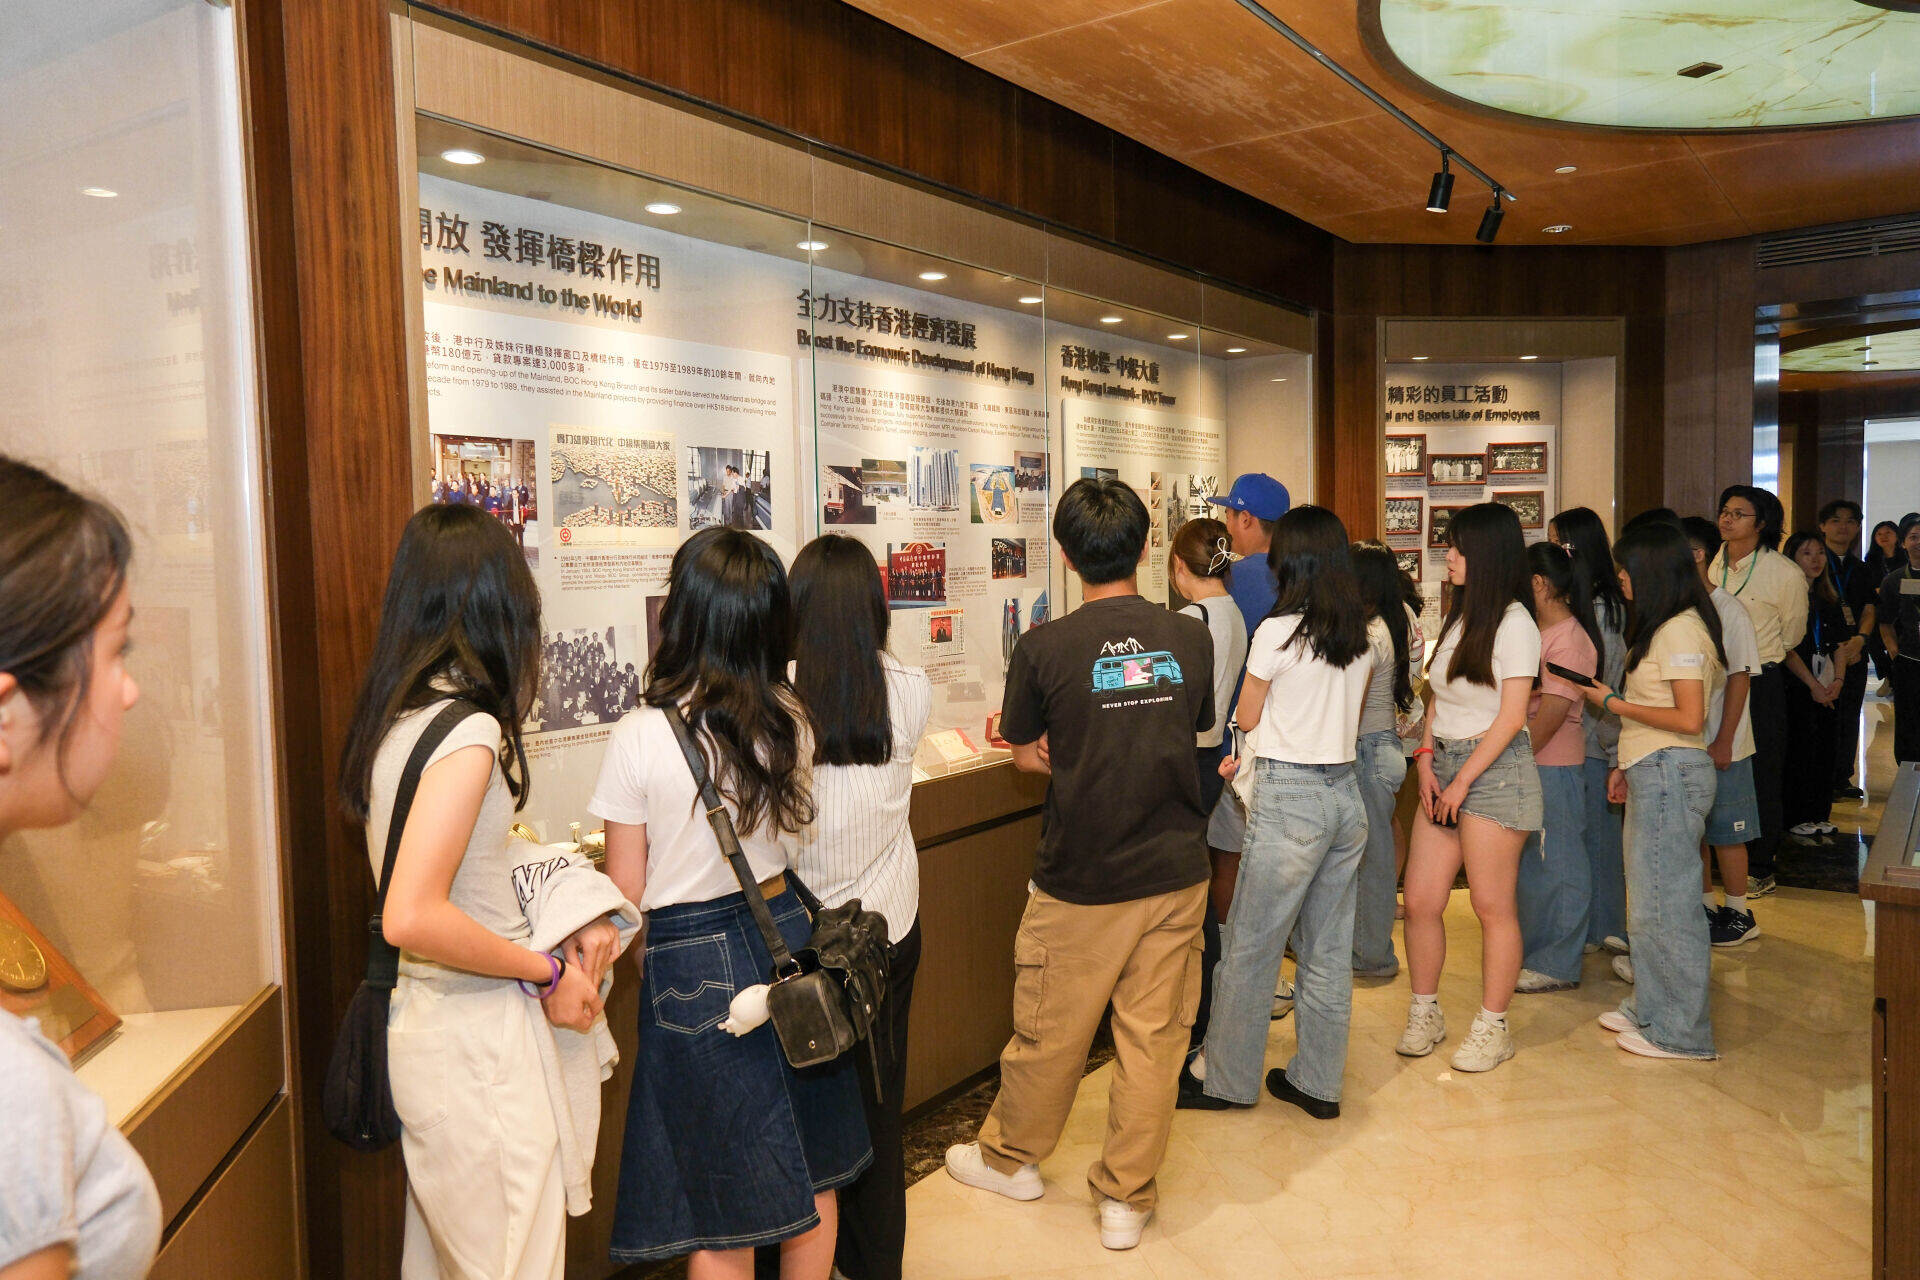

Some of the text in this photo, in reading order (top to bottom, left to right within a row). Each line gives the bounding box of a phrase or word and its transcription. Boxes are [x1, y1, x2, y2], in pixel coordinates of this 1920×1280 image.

[480, 220, 660, 289] 發揮橋樑作用
[443, 266, 533, 301] Mainland
[537, 284, 557, 304] to
[560, 288, 591, 310] the
[593, 292, 642, 318] World
[797, 288, 977, 350] 全力支持香港經濟發展
[836, 336, 855, 353] the
[856, 339, 910, 362] Economic
[912, 349, 974, 372] Development
[976, 362, 986, 375] of
[987, 362, 1010, 382] Hong
[1012, 367, 1034, 385] Kong
[427, 375, 451, 383] ecade
[452, 376, 470, 385] from
[472, 379, 489, 388] 1979
[491, 381, 498, 389] to
[520, 384, 537, 395] they
[572, 389, 583, 398] the
[466, 366, 508, 378] opening-up
[509, 369, 516, 377] of
[518, 371, 529, 379] the
[564, 376, 579, 384] BOC
[581, 377, 598, 388] Hong
[1387, 385, 1508, 404] 精彩的員工活動
[1395, 411, 1414, 422] and
[1418, 410, 1450, 424] Sports
[1453, 410, 1470, 420] Life
[1472, 409, 1483, 420] of
[1486, 409, 1540, 423] Employees
[1140, 696, 1173, 705] EXPLORING
